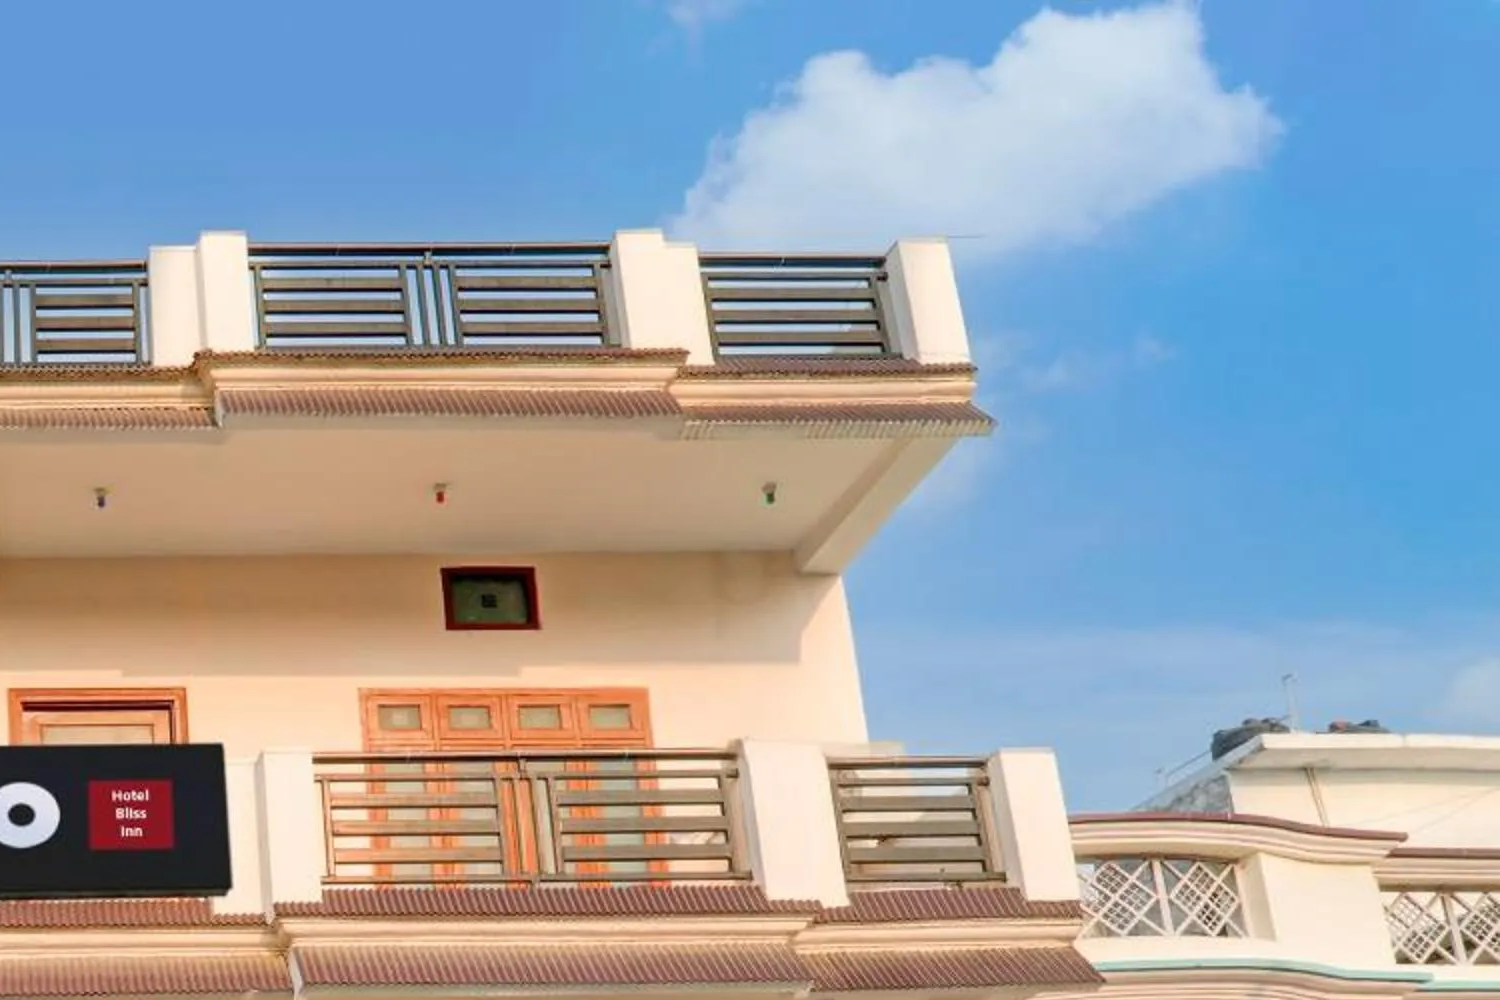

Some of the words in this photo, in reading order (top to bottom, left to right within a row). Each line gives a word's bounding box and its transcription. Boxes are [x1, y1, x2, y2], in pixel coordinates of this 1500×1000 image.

[111, 789, 150, 802] Hotel
[115, 807, 148, 820] Bliss
[120, 825, 143, 838] Inn
